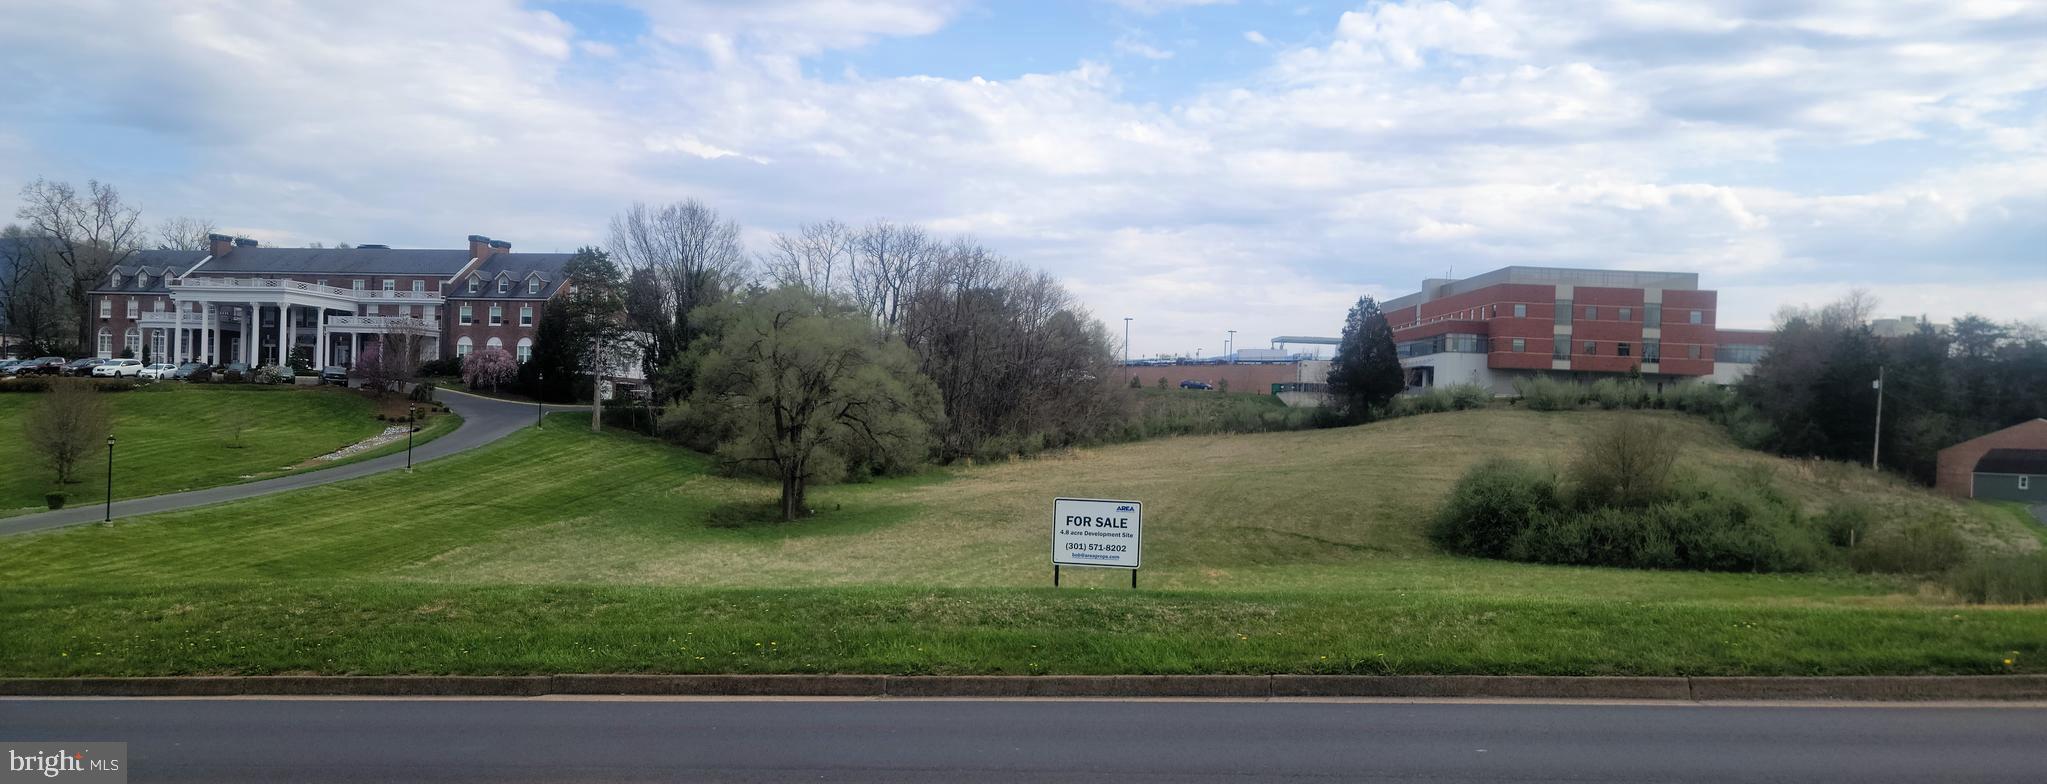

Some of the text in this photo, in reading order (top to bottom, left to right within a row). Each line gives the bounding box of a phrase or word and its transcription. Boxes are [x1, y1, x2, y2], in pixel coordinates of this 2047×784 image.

[1066, 515, 1128, 528] FOR SALE
[1065, 542, 1127, 552] (301) 571-8202
